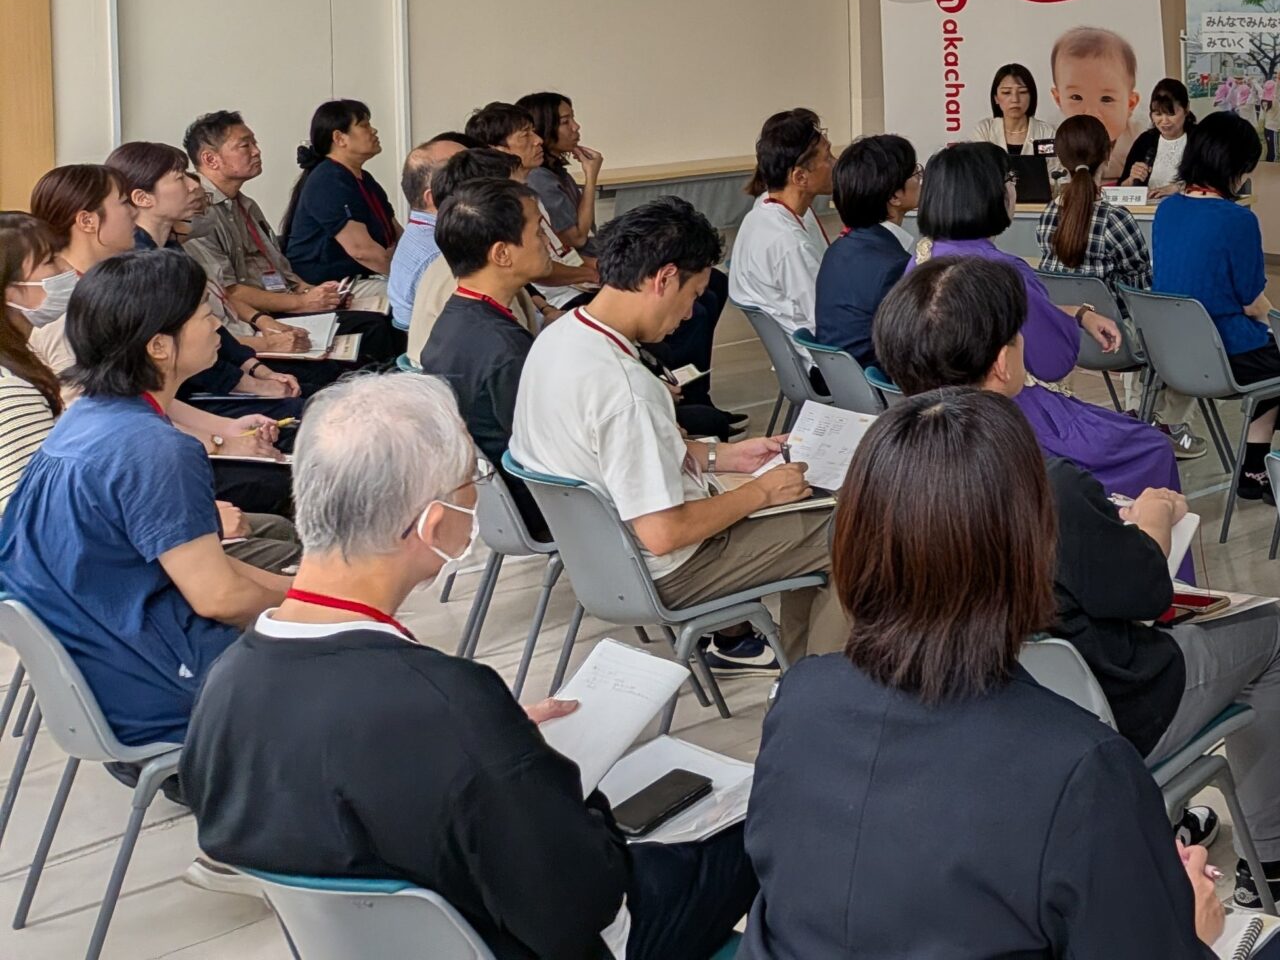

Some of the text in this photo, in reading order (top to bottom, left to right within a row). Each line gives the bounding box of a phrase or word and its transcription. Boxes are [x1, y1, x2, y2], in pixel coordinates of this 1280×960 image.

[1206, 37, 1245, 49] みていく
[943, 19, 965, 131] akachan
